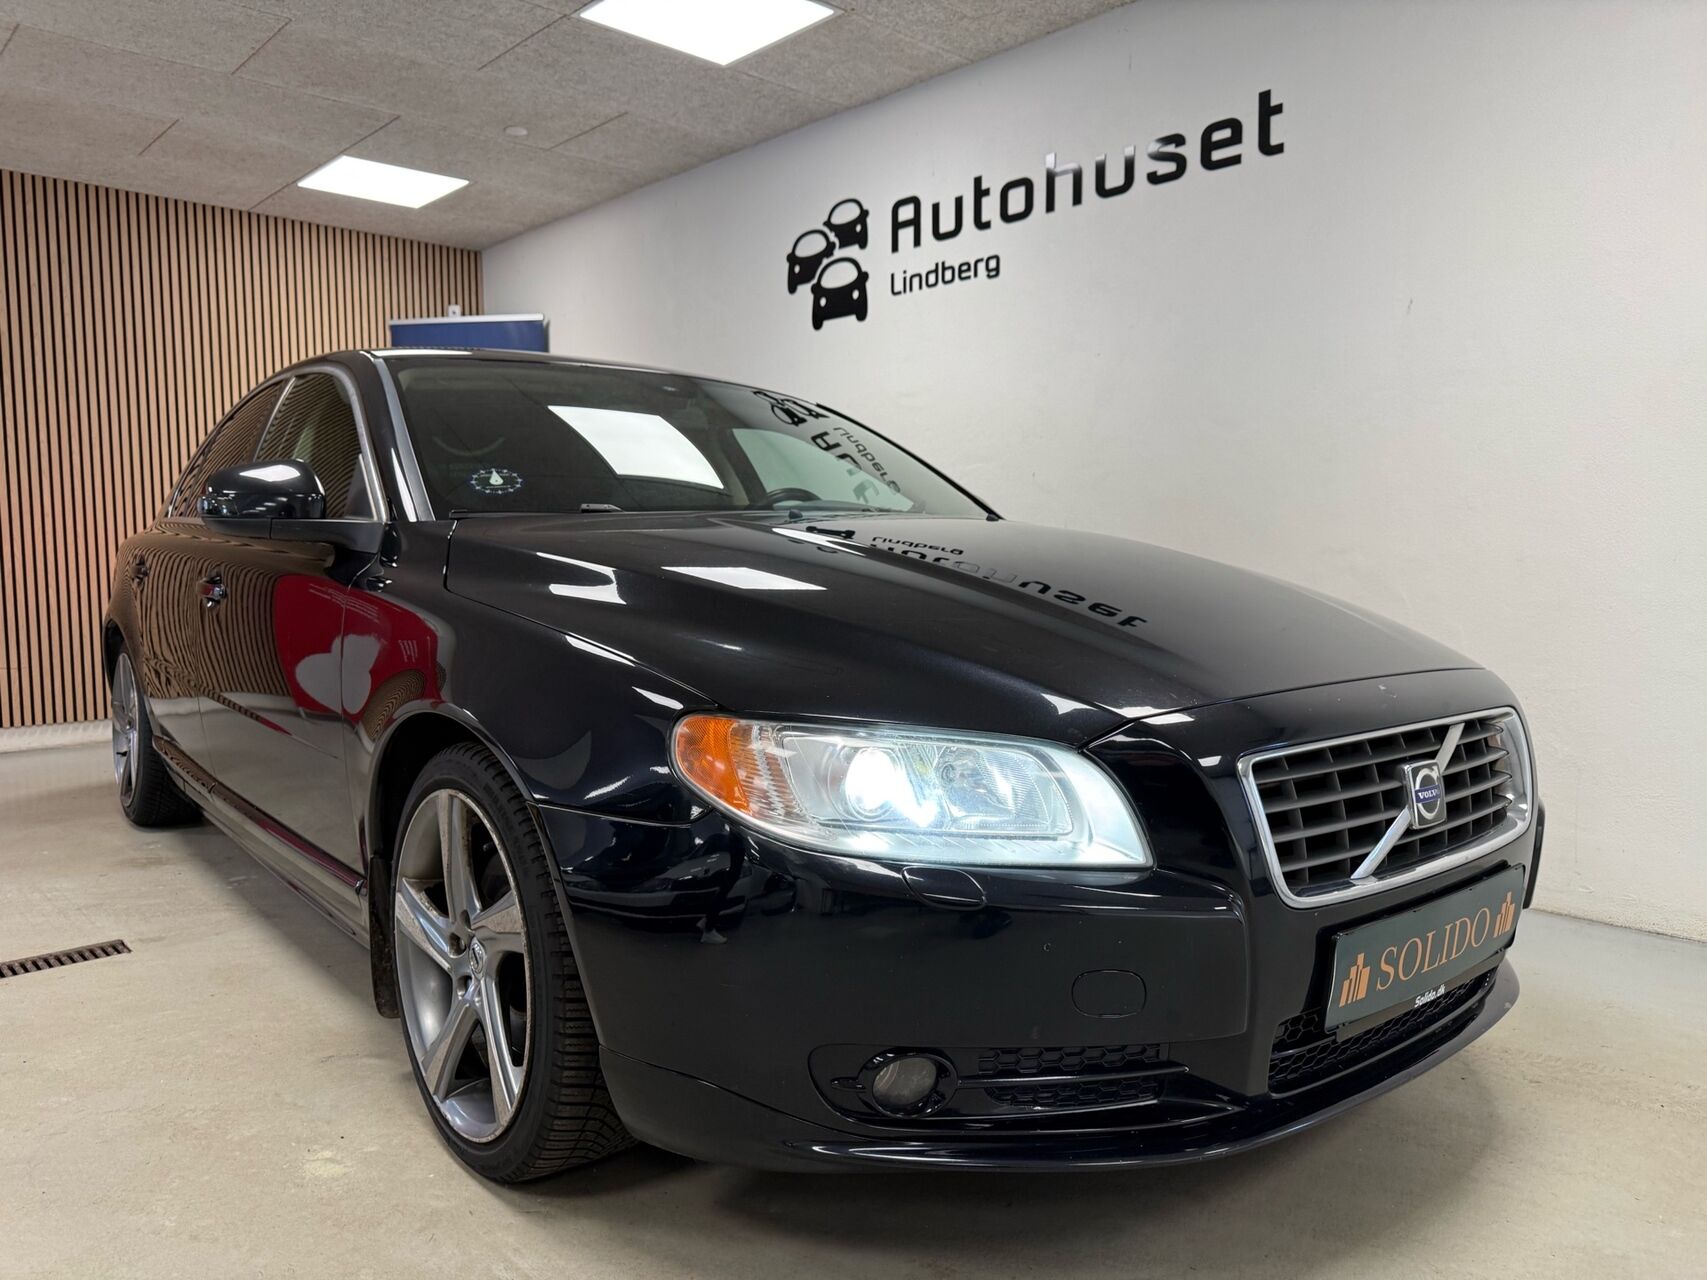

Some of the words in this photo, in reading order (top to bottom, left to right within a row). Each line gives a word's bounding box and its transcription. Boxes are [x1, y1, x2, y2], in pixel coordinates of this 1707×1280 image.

[891, 88, 1285, 254] Autohuset
[889, 254, 1001, 297] Lindberg
[1375, 907, 1491, 991] SOLIDO
